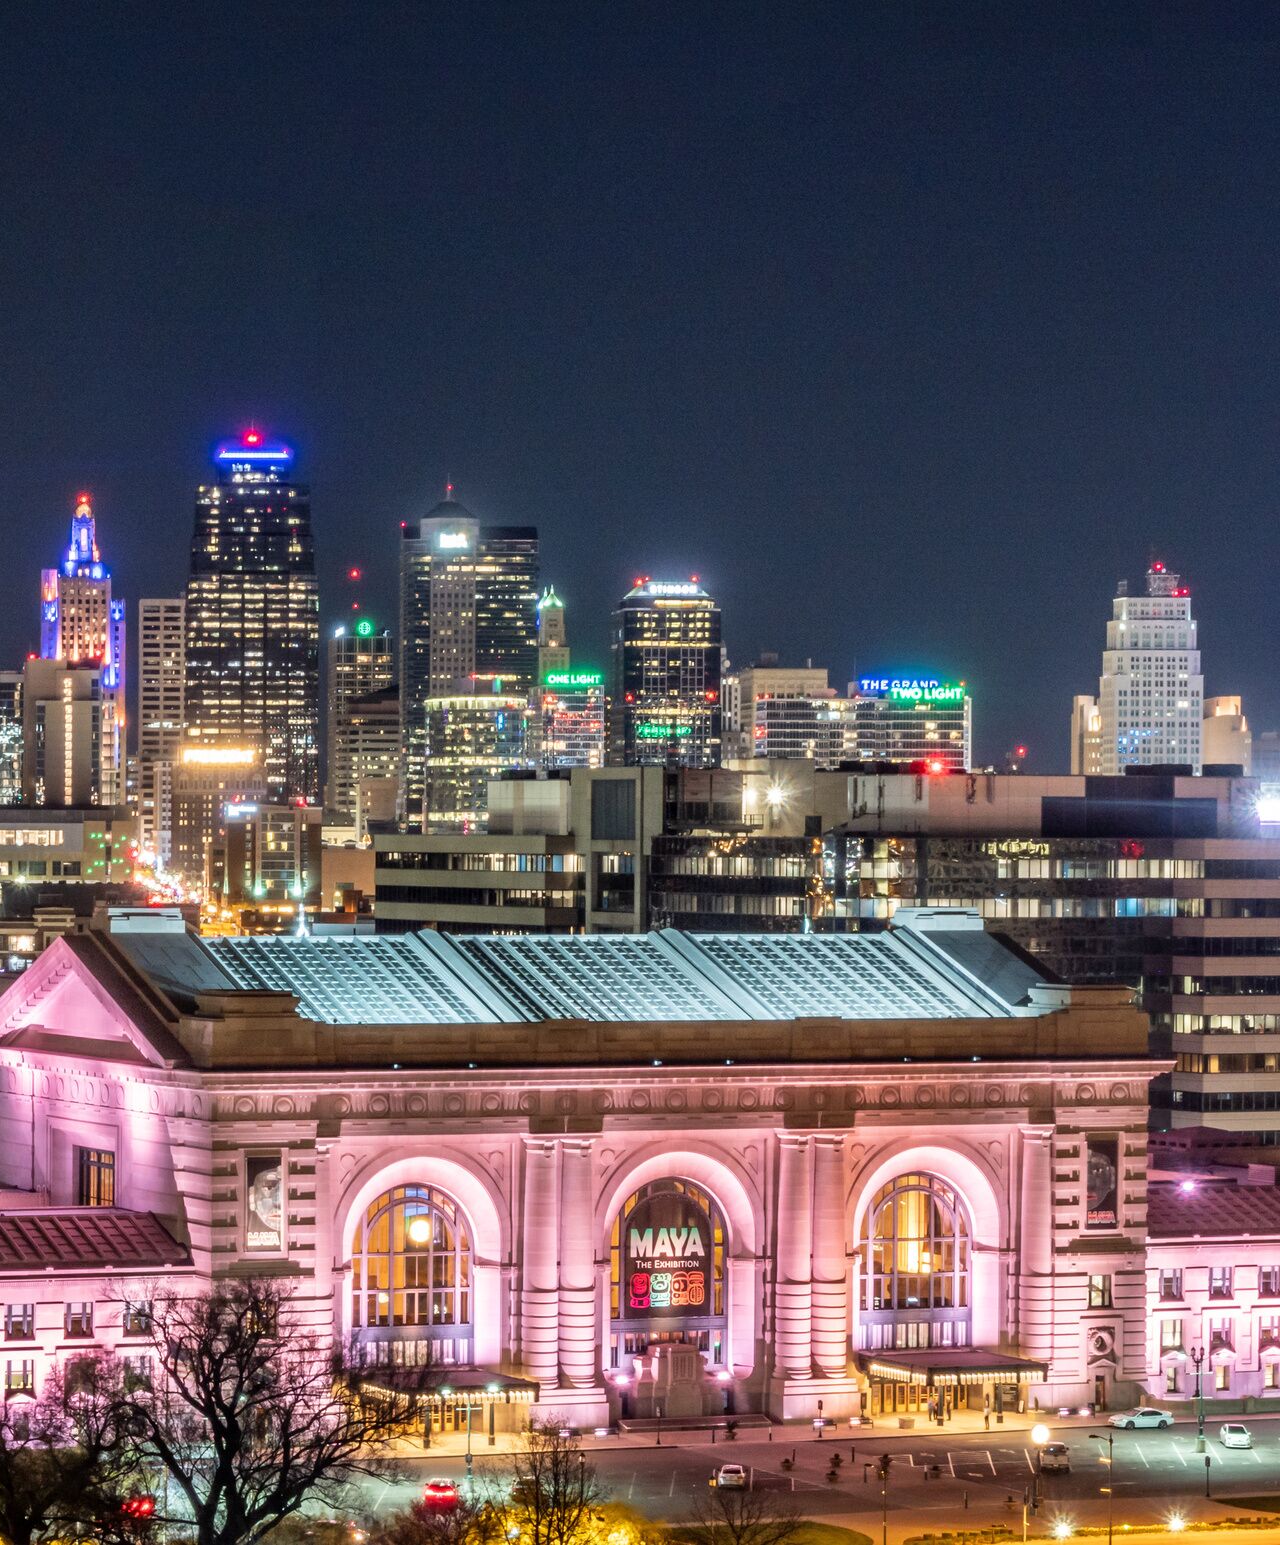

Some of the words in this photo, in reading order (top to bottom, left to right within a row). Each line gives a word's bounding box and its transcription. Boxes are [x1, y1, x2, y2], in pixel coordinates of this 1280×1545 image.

[547, 674, 569, 684] ONE
[571, 674, 600, 684] LIGHT
[861, 680, 889, 690] THE
[891, 680, 939, 689] GRAND
[891, 688, 922, 700] TWO
[924, 688, 962, 700] LIGHT
[630, 1227, 705, 1258] MAYA
[635, 1260, 652, 1269] THE
[654, 1259, 700, 1269] EXHIBITION
